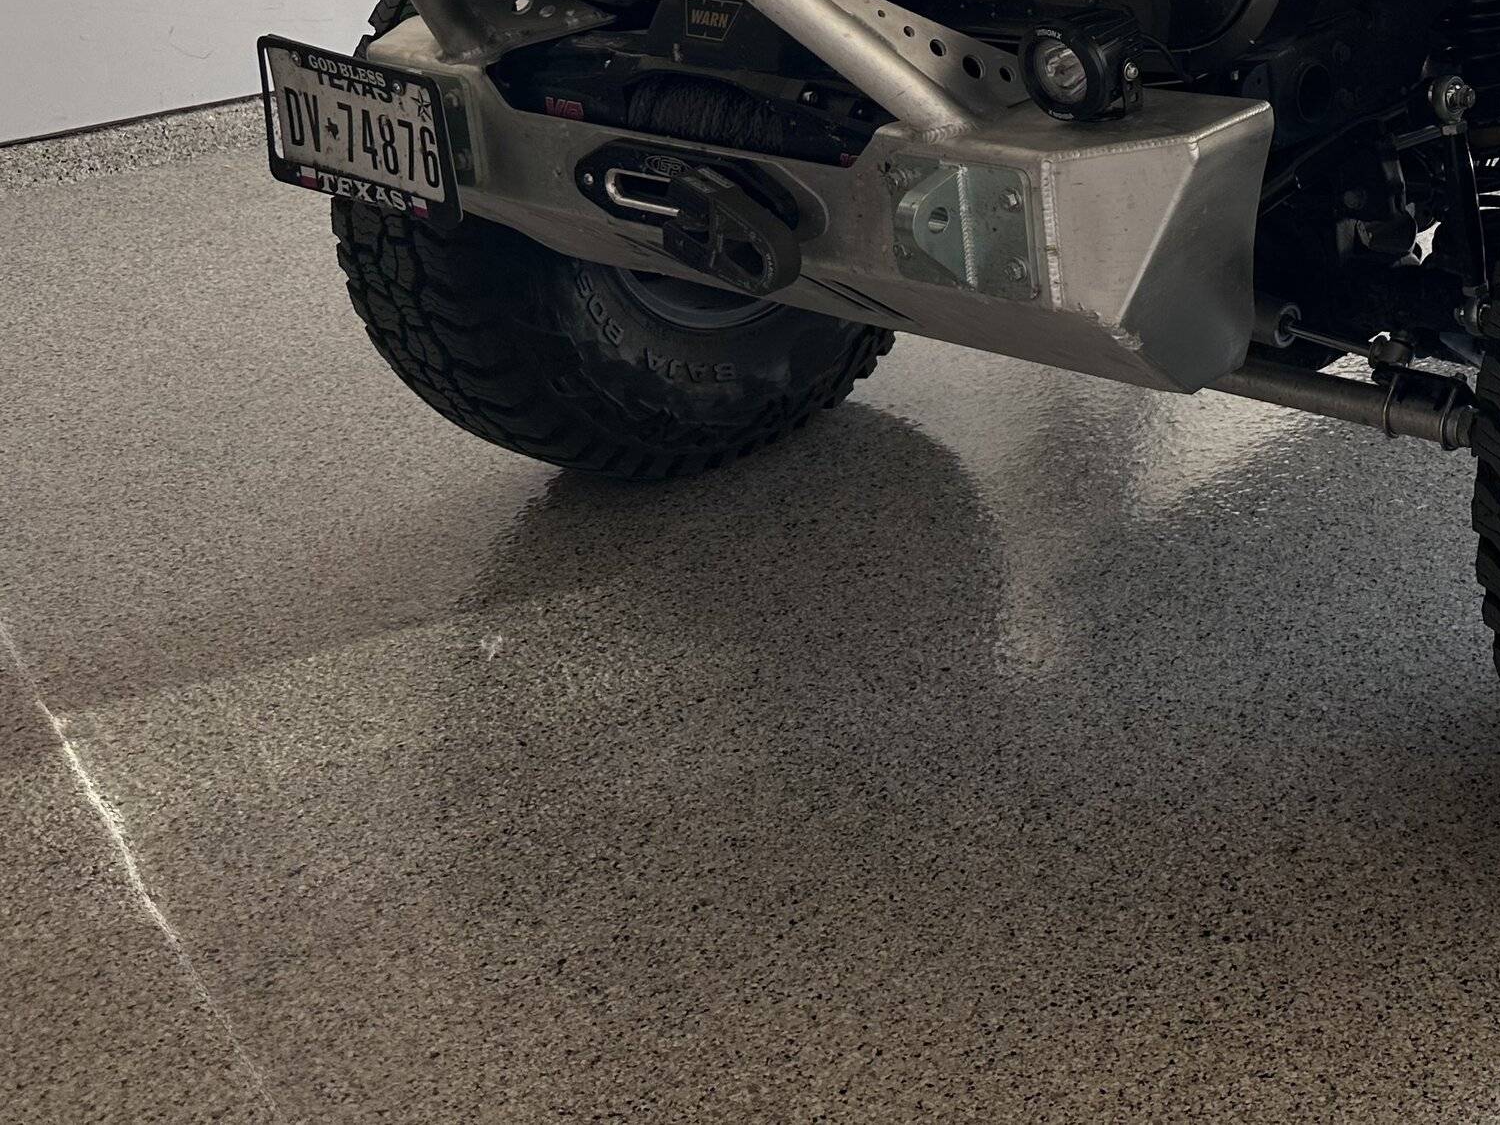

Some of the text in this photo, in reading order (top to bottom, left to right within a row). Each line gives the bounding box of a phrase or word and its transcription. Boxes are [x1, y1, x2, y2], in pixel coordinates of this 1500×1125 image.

[690, 8, 730, 29] WARN
[307, 53, 387, 87] GOD BLESS
[284, 86, 441, 189] DV 74876
[316, 171, 407, 211] TEXAS
